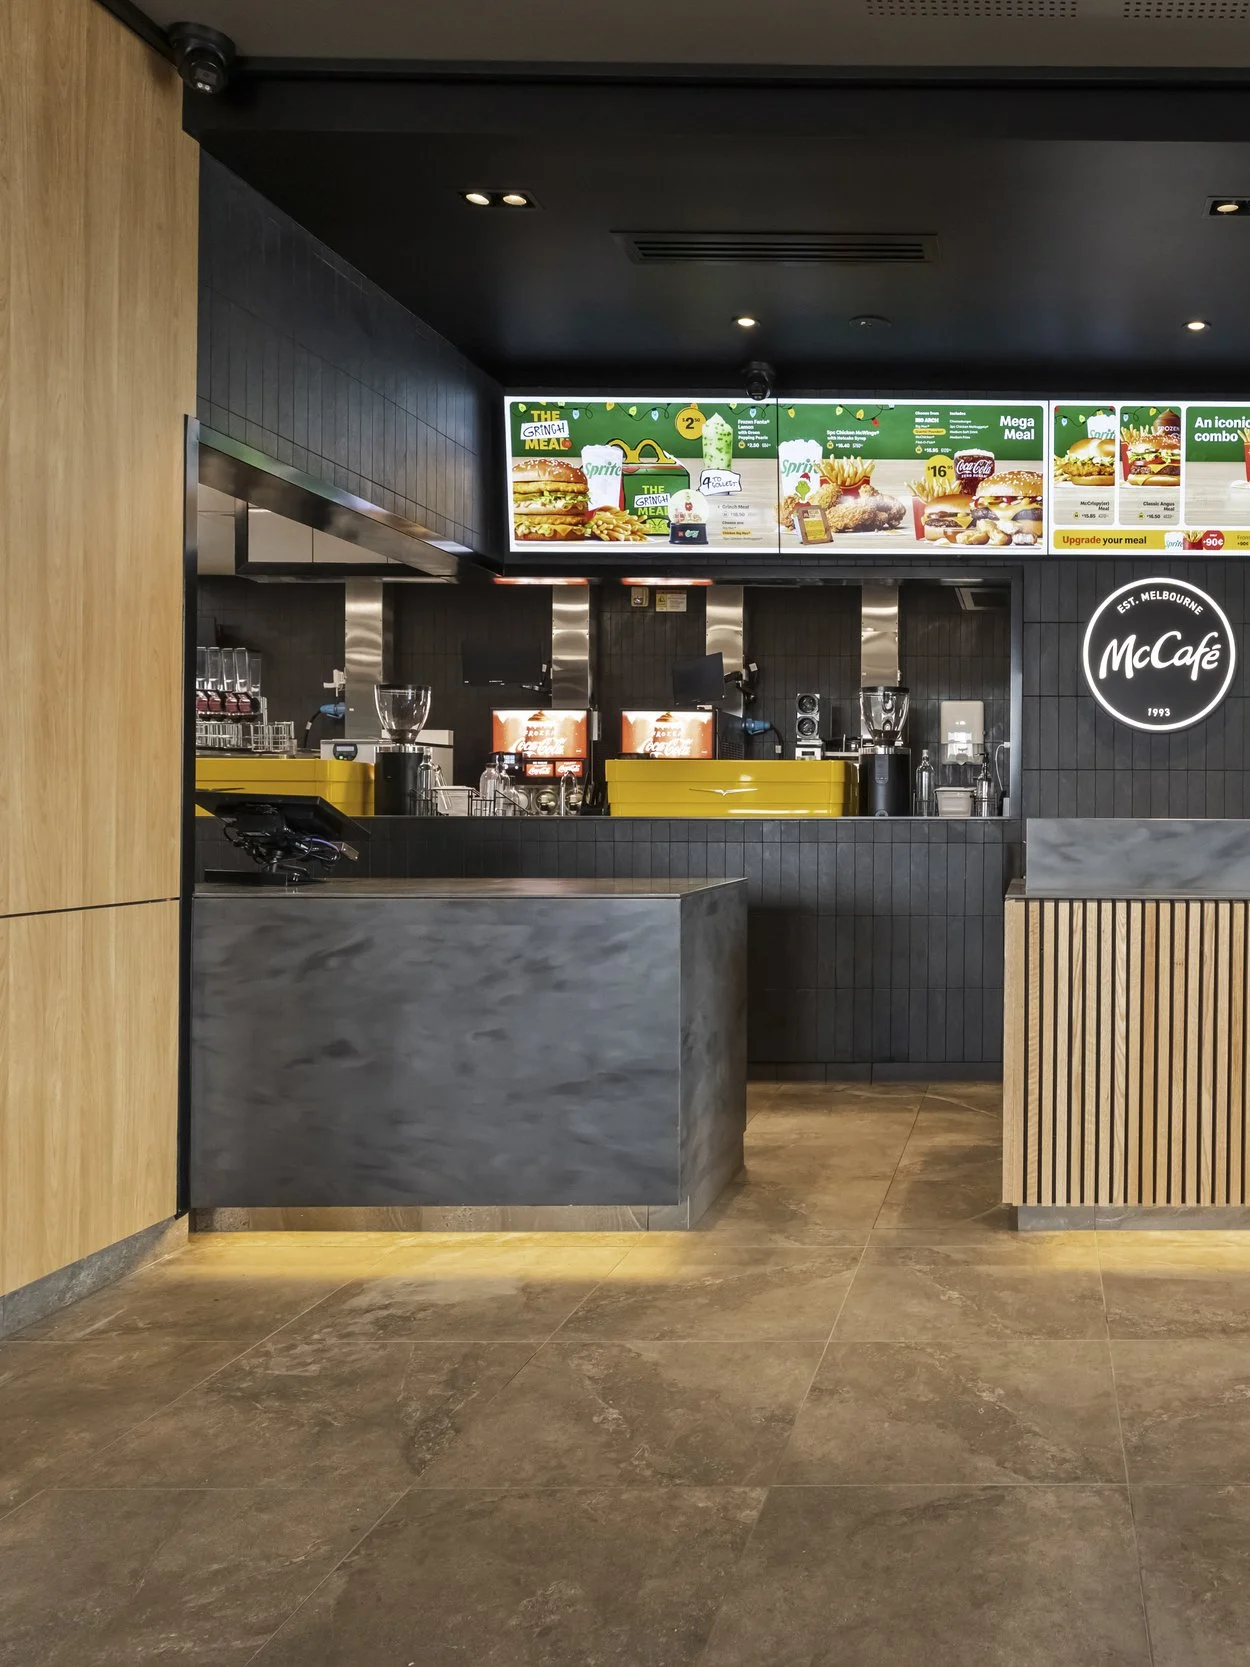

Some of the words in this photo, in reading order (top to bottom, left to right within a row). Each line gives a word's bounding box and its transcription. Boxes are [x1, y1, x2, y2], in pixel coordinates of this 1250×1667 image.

[531, 410, 560, 422] THE
[1194, 416, 1213, 428] An
[999, 415, 1035, 430] Mega
[523, 422, 565, 438] GRINCH
[1003, 428, 1035, 440] Meal
[1194, 430, 1239, 442] combo
[584, 461, 622, 479] Sprite
[702, 476, 711, 490] 4
[642, 485, 665, 494] THE
[635, 494, 669, 507] GRINCH
[1062, 535, 1101, 546] Upgrade
[1102, 537, 1122, 546] your
[1124, 536, 1147, 544] meal
[1116, 597, 1139, 614] EST.
[1141, 590, 1204, 616] MELBOURNE
[1098, 630, 1222, 681] McCafé
[1147, 707, 1171, 717] 1993
